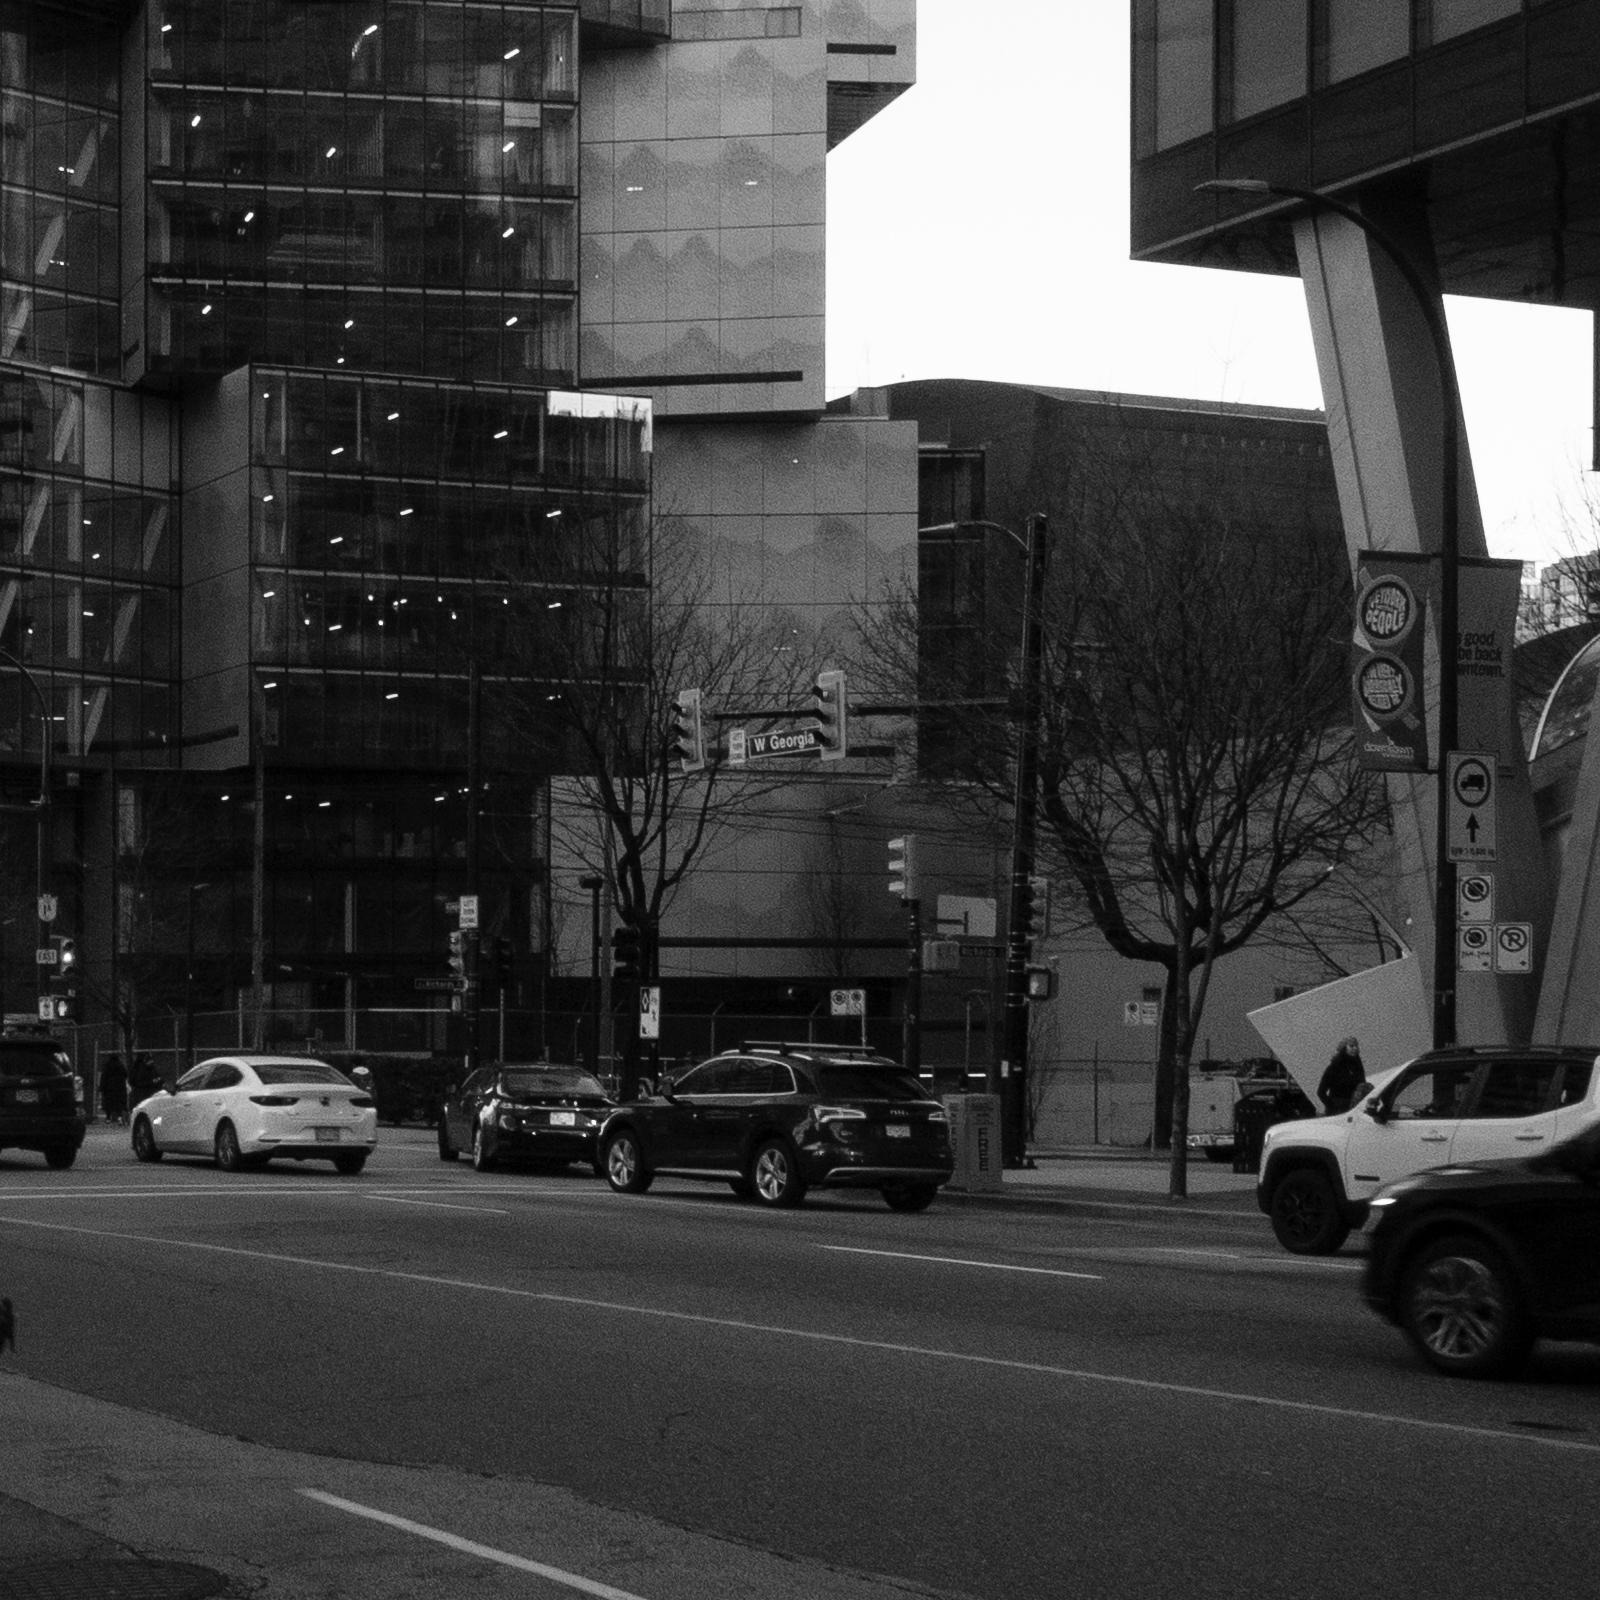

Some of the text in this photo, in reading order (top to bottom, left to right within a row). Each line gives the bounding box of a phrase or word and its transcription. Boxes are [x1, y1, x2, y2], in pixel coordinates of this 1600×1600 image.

[1464, 630, 1496, 647] good
[1474, 645, 1503, 661] back
[753, 737, 766, 752] W
[769, 730, 815, 749] Georgia
